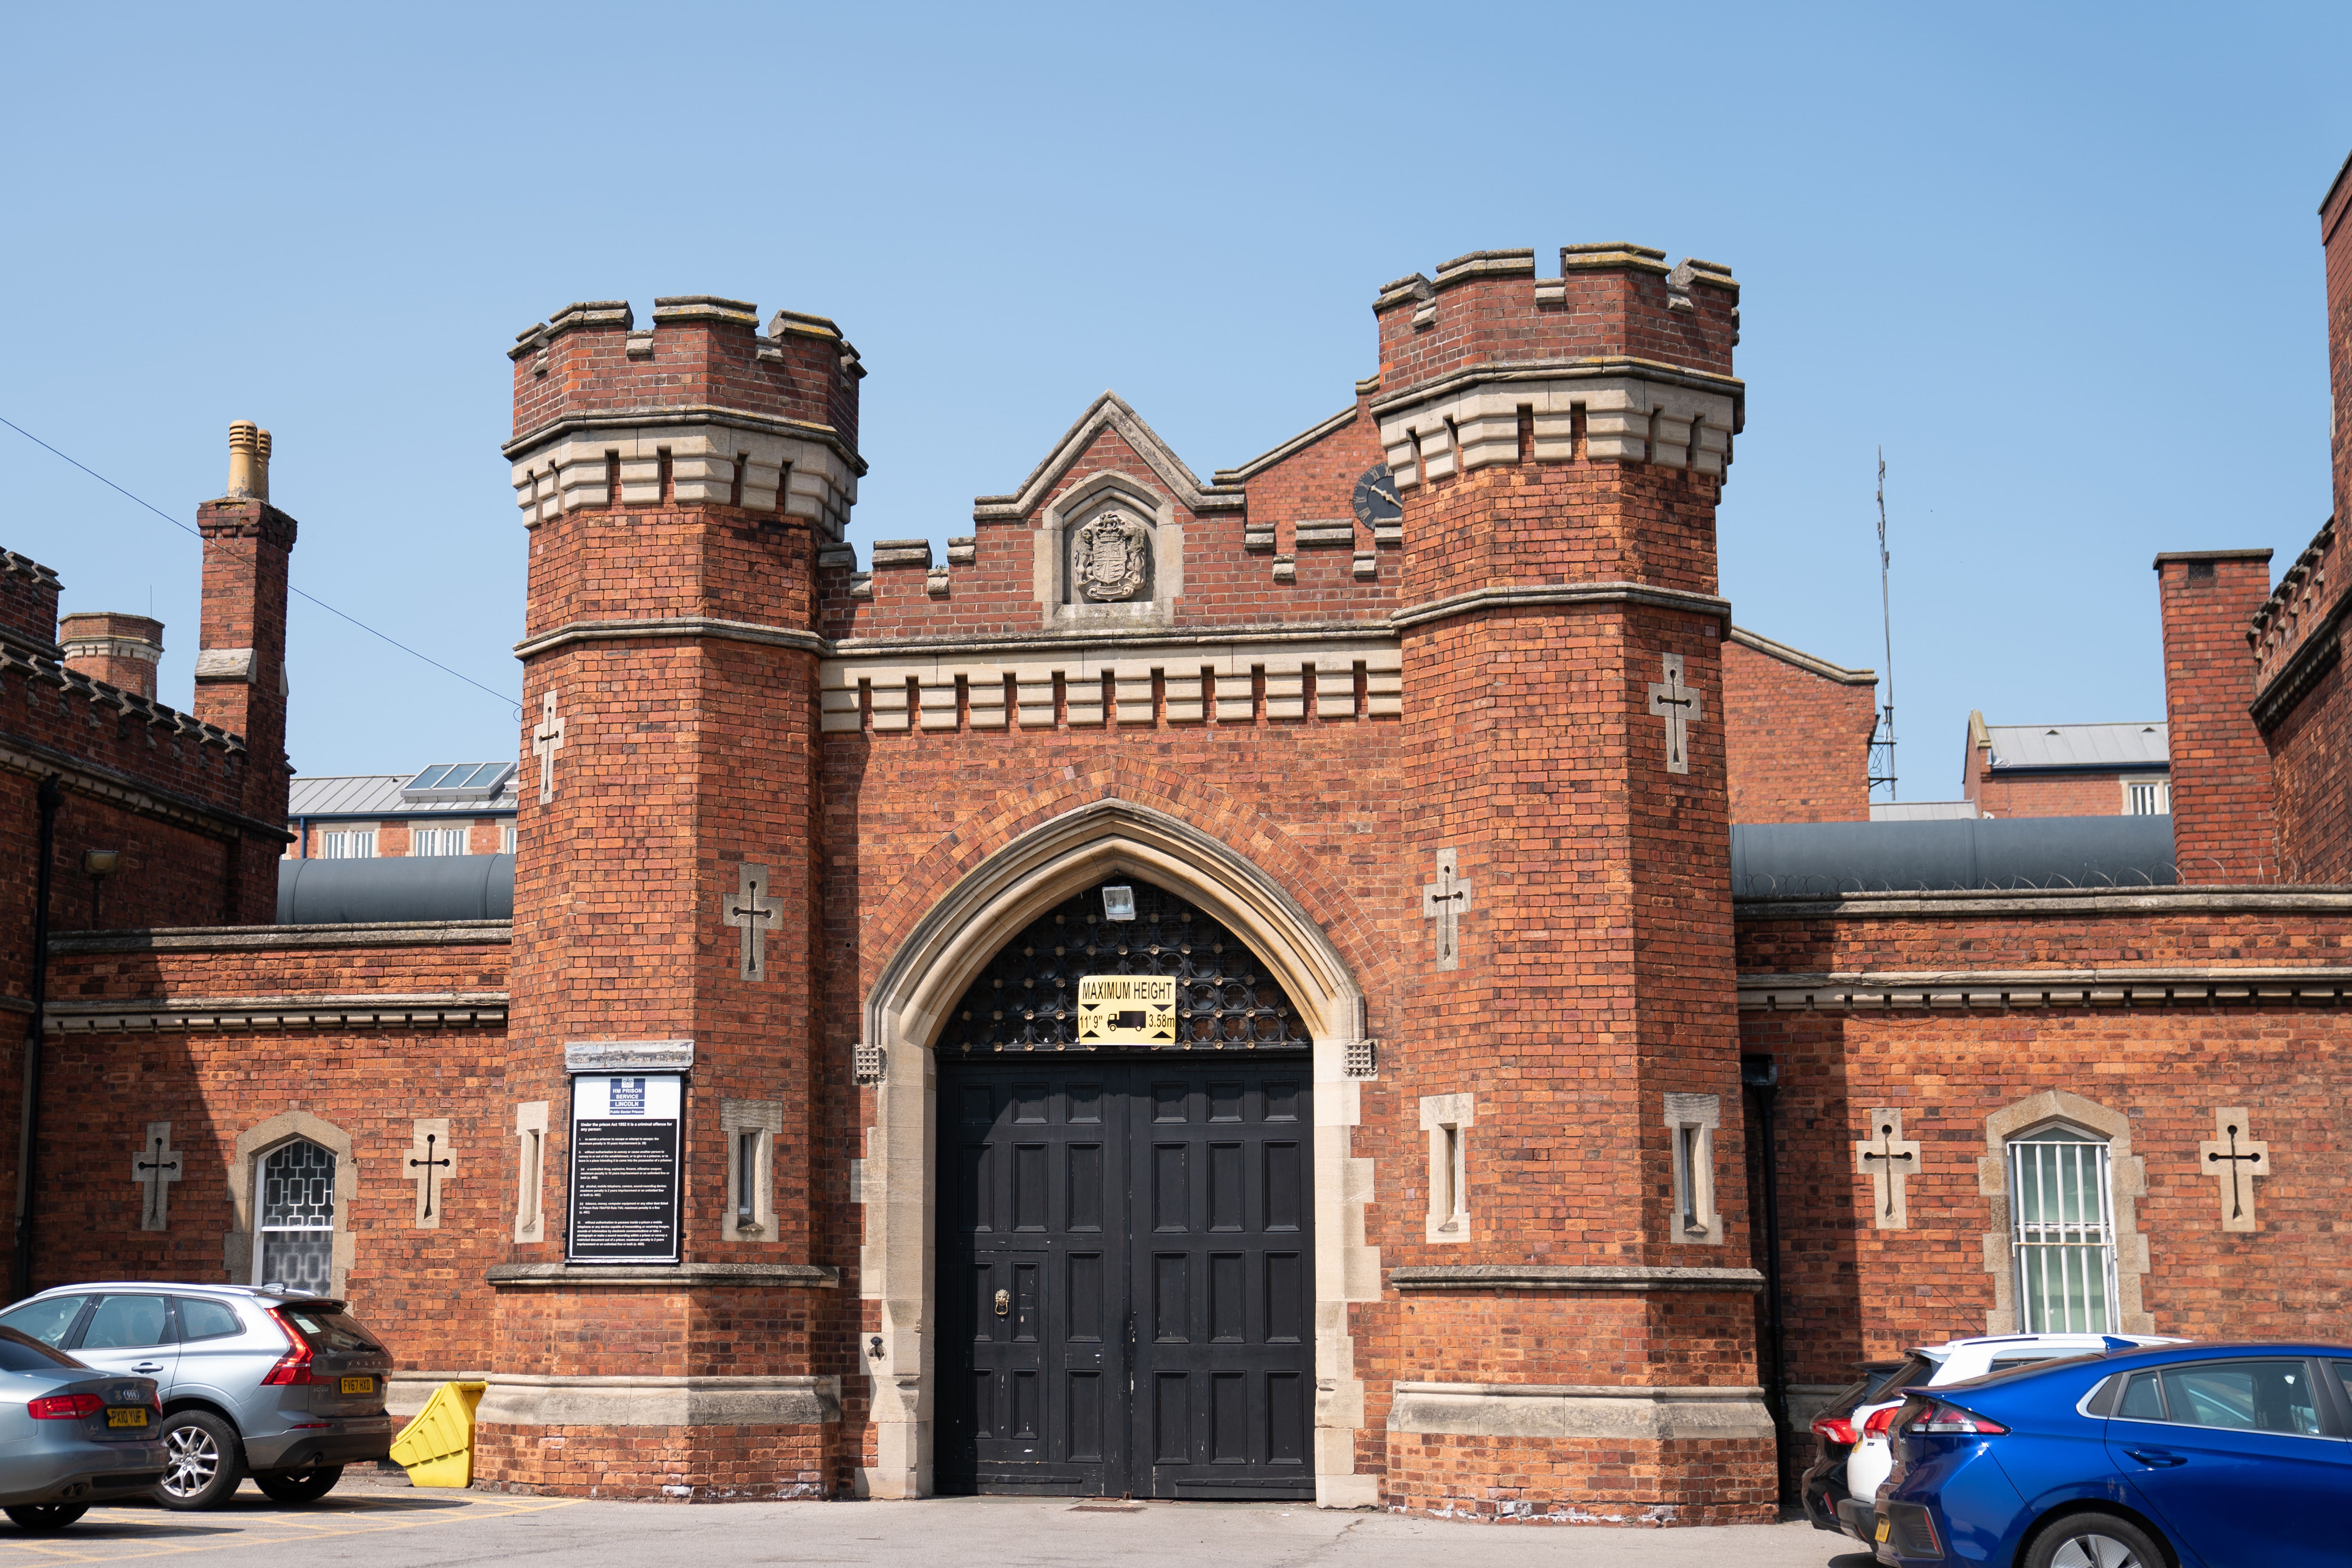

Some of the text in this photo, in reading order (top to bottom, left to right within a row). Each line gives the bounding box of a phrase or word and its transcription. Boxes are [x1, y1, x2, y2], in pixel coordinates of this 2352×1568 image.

[1083, 982, 1172, 999] MAXIMUM HEIGHT
[1080, 1015, 1102, 1028] 11' 9"
[1149, 1014, 1174, 1027] 3.58m
[343, 1379, 370, 1391] FV67 HXD
[111, 1410, 141, 1424] PX10 YUF
